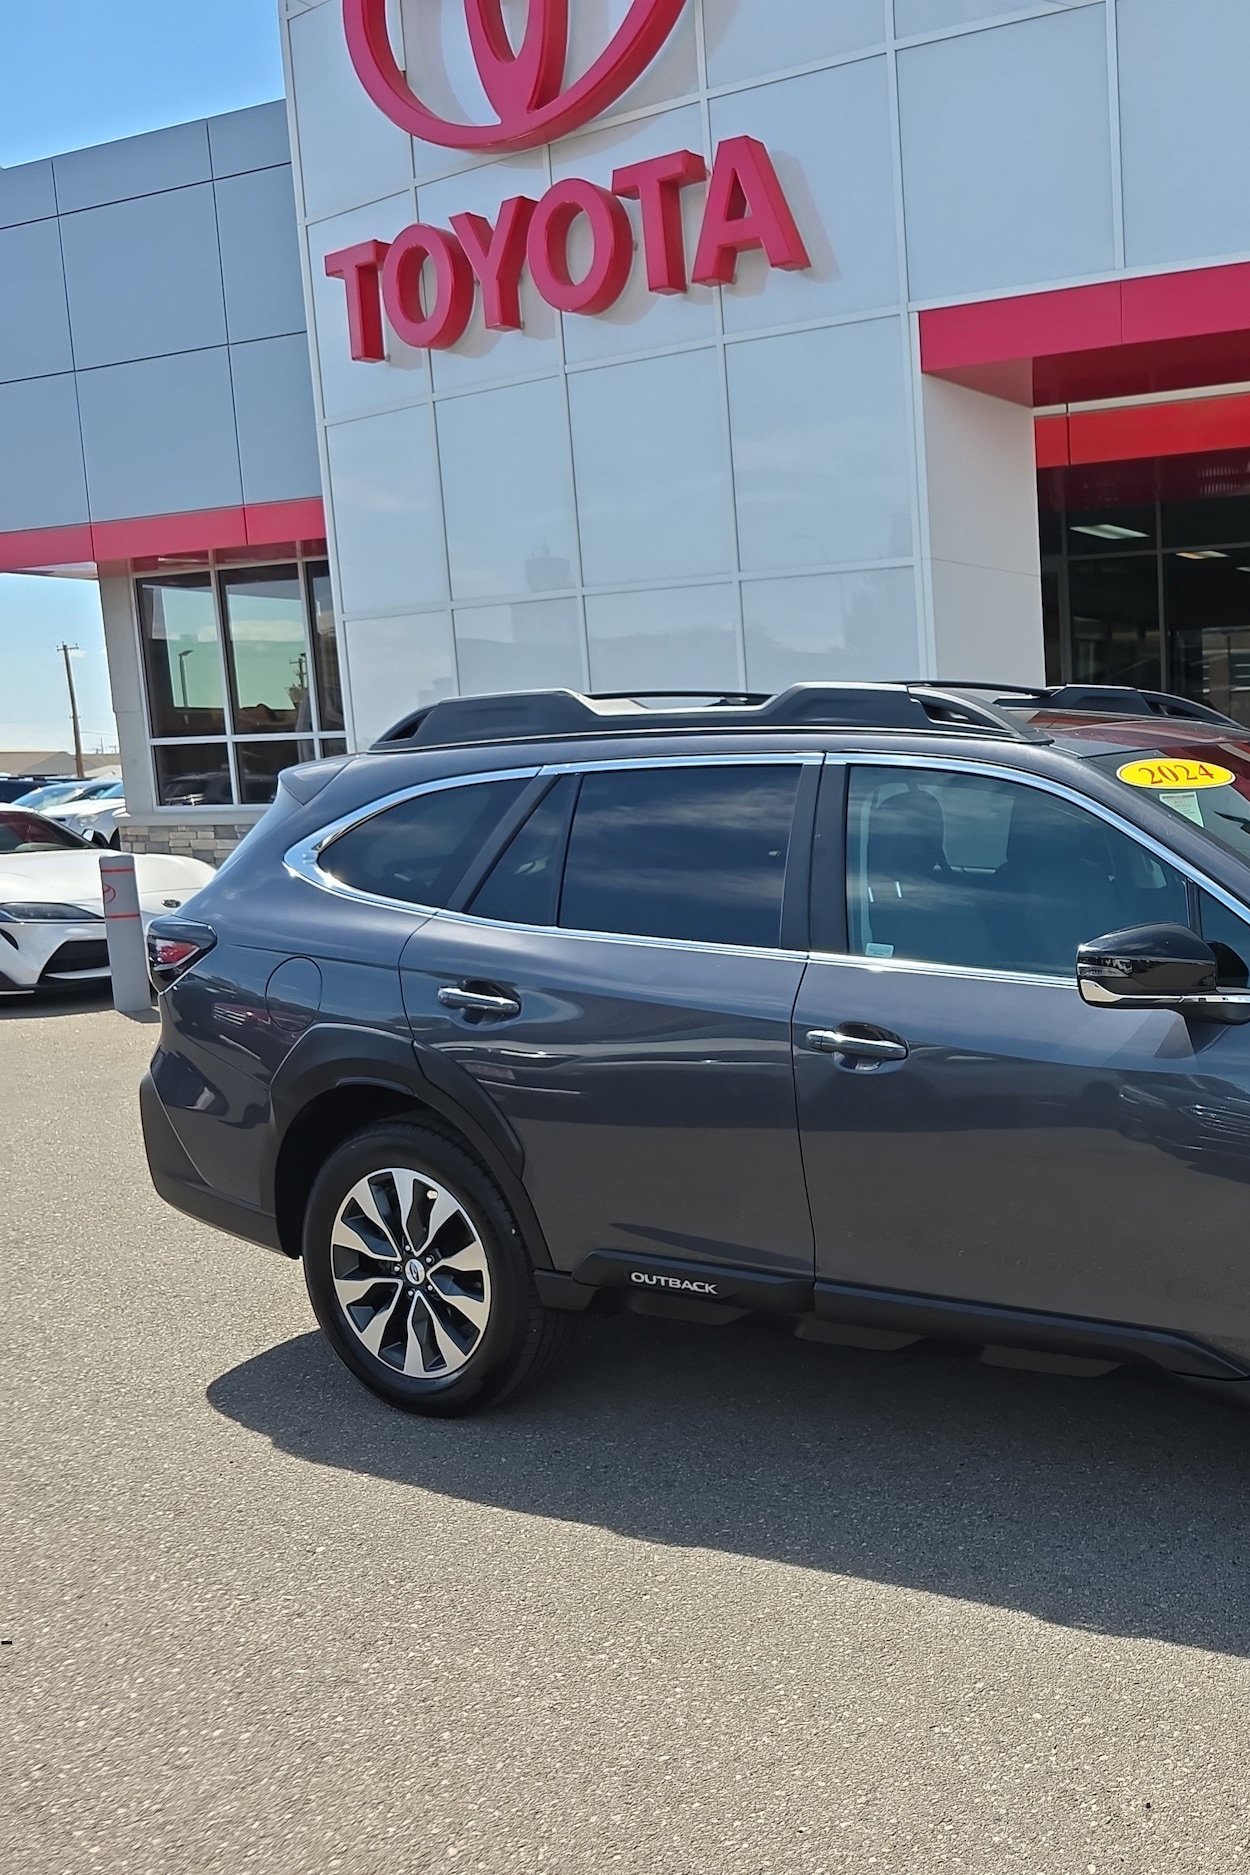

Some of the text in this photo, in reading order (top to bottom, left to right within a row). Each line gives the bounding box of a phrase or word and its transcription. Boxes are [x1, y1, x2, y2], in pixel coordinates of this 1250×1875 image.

[324, 135, 812, 363] TOYOTA
[1138, 763, 1215, 785] 2024
[630, 1271, 719, 1295] OUTBACK
